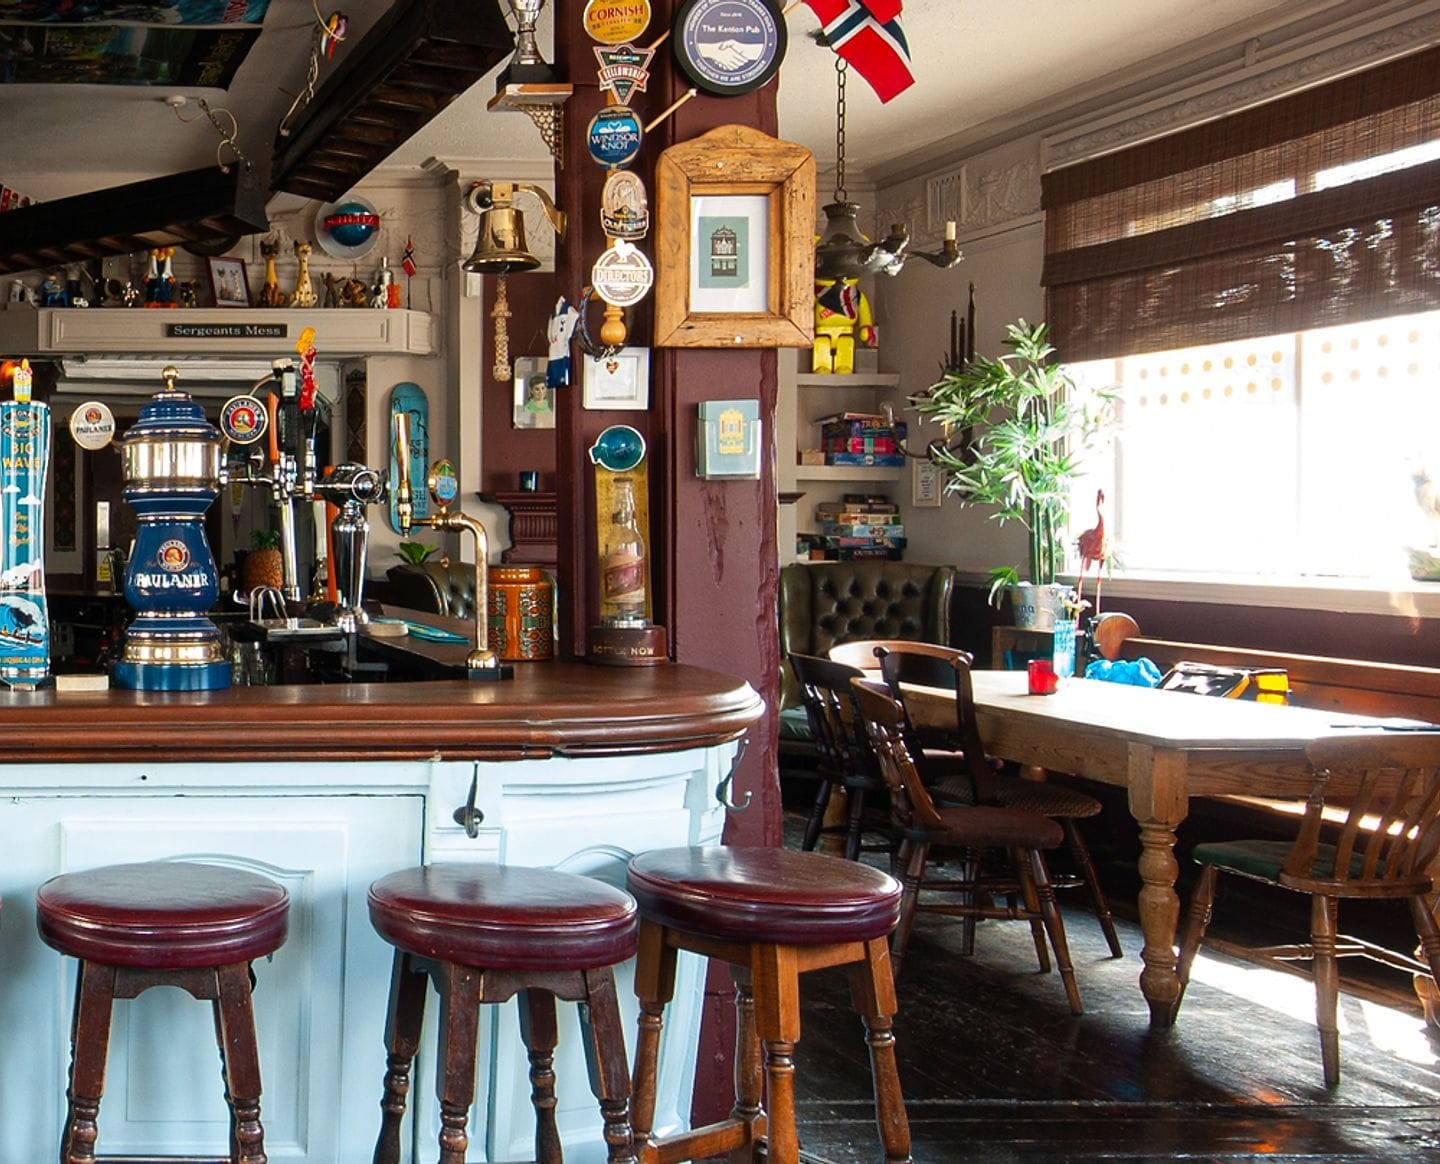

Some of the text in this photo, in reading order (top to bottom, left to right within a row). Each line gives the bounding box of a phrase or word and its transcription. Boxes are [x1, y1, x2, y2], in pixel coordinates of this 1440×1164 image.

[589, 5, 644, 22] CORNISH
[745, 25, 760, 34] Pub
[591, 132, 638, 144] WINDSOR
[596, 268, 649, 283] DIRECTORS
[174, 325, 280, 337] Sergeants Mess
[75, 424, 113, 434] PAULANER
[12, 442, 34, 455] BIG
[2, 457, 40, 470] WAVE
[135, 573, 209, 589] PAULANER
[630, 646, 655, 656] NOW
